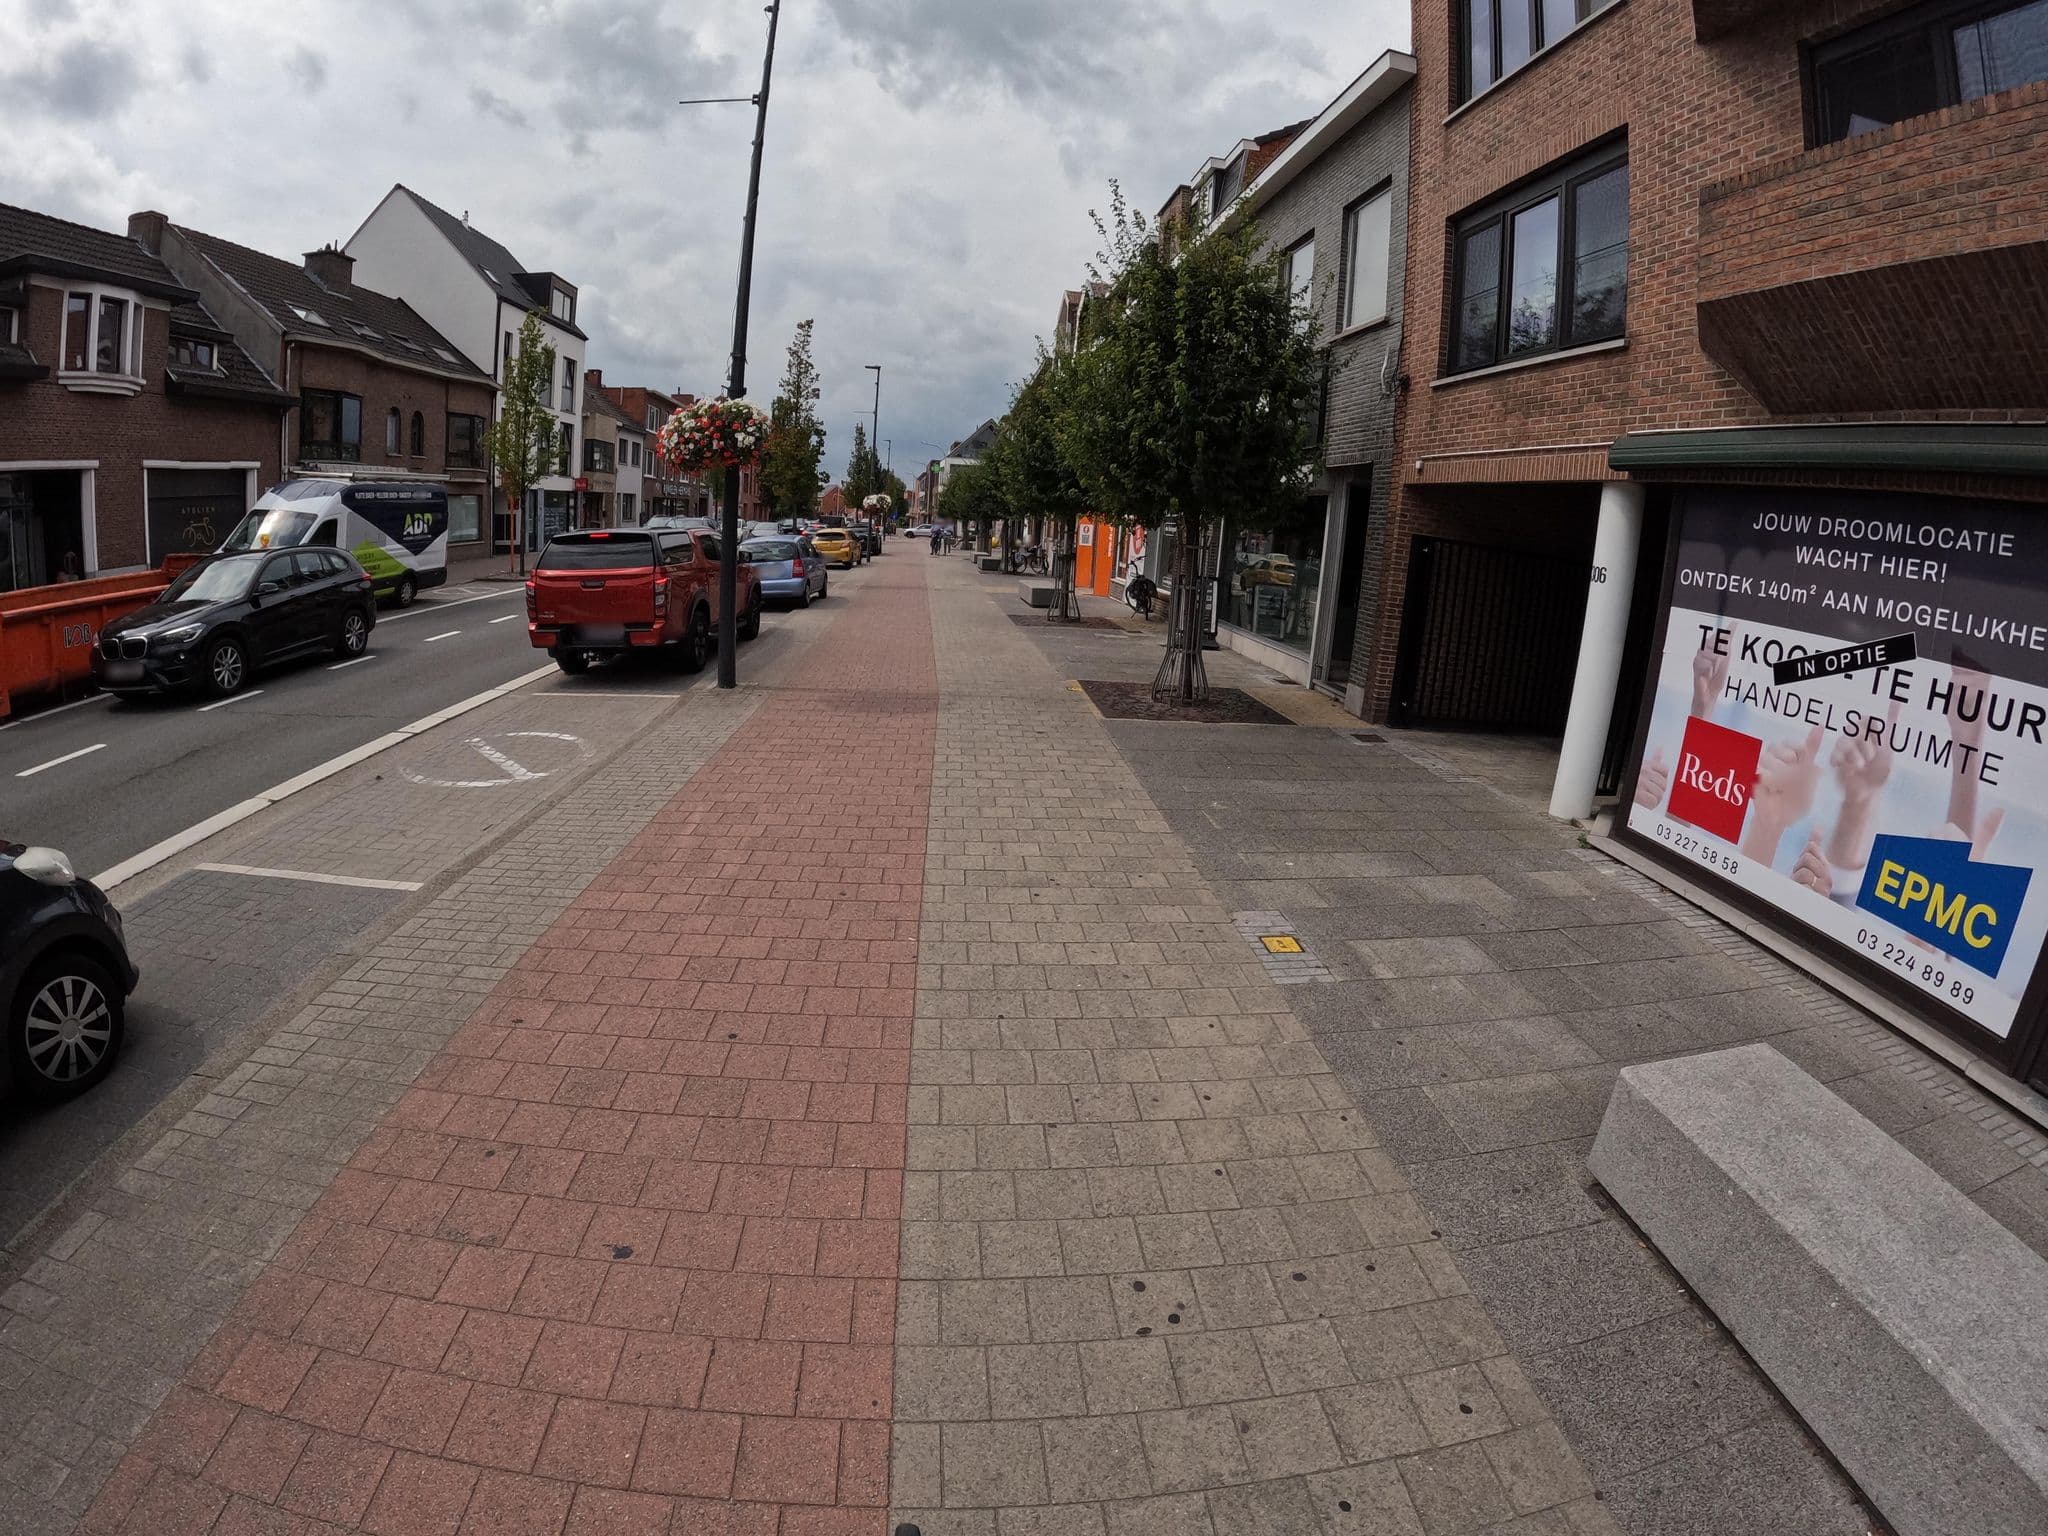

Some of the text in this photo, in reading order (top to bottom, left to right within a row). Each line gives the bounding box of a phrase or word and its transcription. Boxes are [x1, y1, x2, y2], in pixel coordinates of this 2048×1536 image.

[1753, 512, 2015, 556] JOUW DROOMLOCATIE
[1796, 545, 1947, 583] WACHT HIER!
[1680, 568, 1753, 594] ONTDEK
[1822, 590, 1868, 615] AAN
[1876, 598, 2047, 651] MOGELIJKHE
[1699, 624, 1731, 656] TE
[1741, 633, 1826, 668] KO
[1871, 666, 1913, 703] TE
[1926, 678, 2046, 744] HUUR
[1797, 645, 1887, 677] IN OPTIE
[1724, 676, 2004, 786] HANDELSRUIMTE
[1680, 752, 1745, 806] Reds
[1656, 824, 1738, 874] 03 227 58 58
[1874, 859, 1997, 949] EPMC
[1857, 928, 1974, 1005] 03 224 89 89
